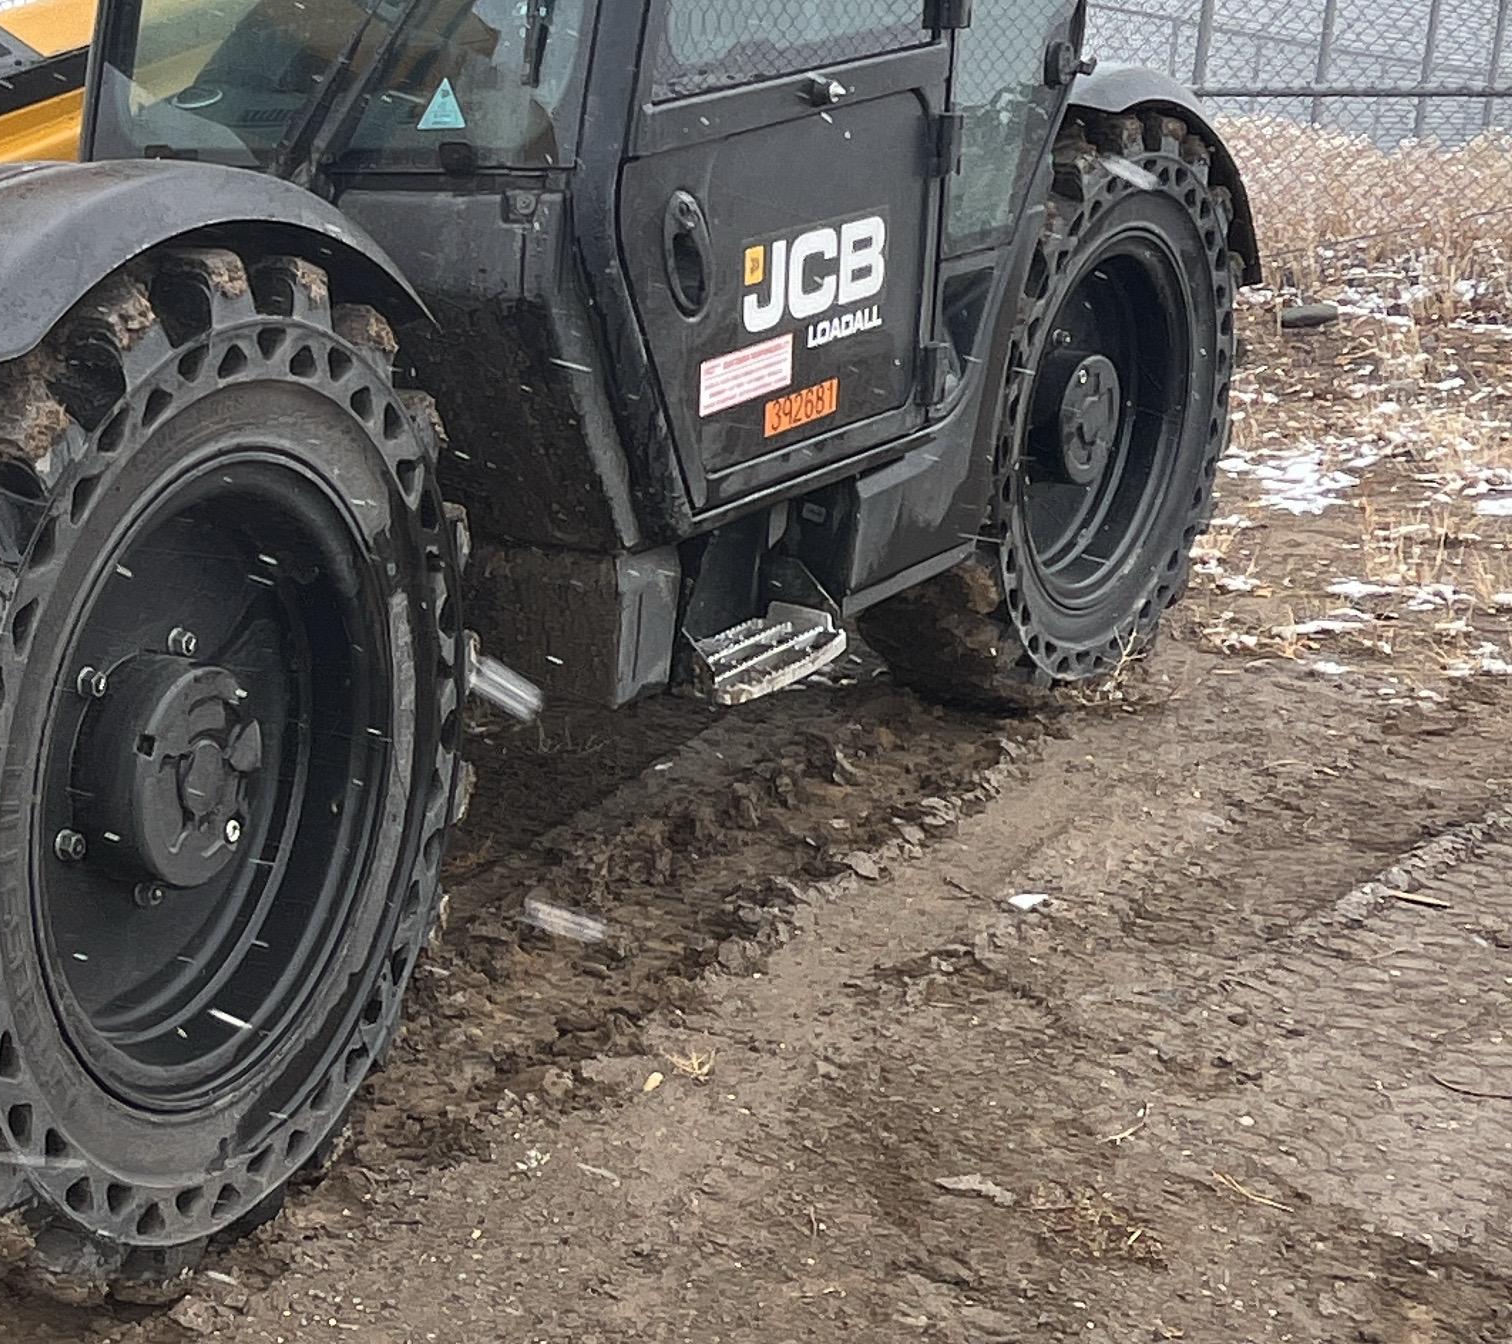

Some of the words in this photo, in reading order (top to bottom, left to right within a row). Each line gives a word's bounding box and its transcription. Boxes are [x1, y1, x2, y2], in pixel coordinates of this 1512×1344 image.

[743, 216, 885, 333] JCB
[807, 305, 883, 348] LOADALL
[771, 381, 835, 431] 392681
